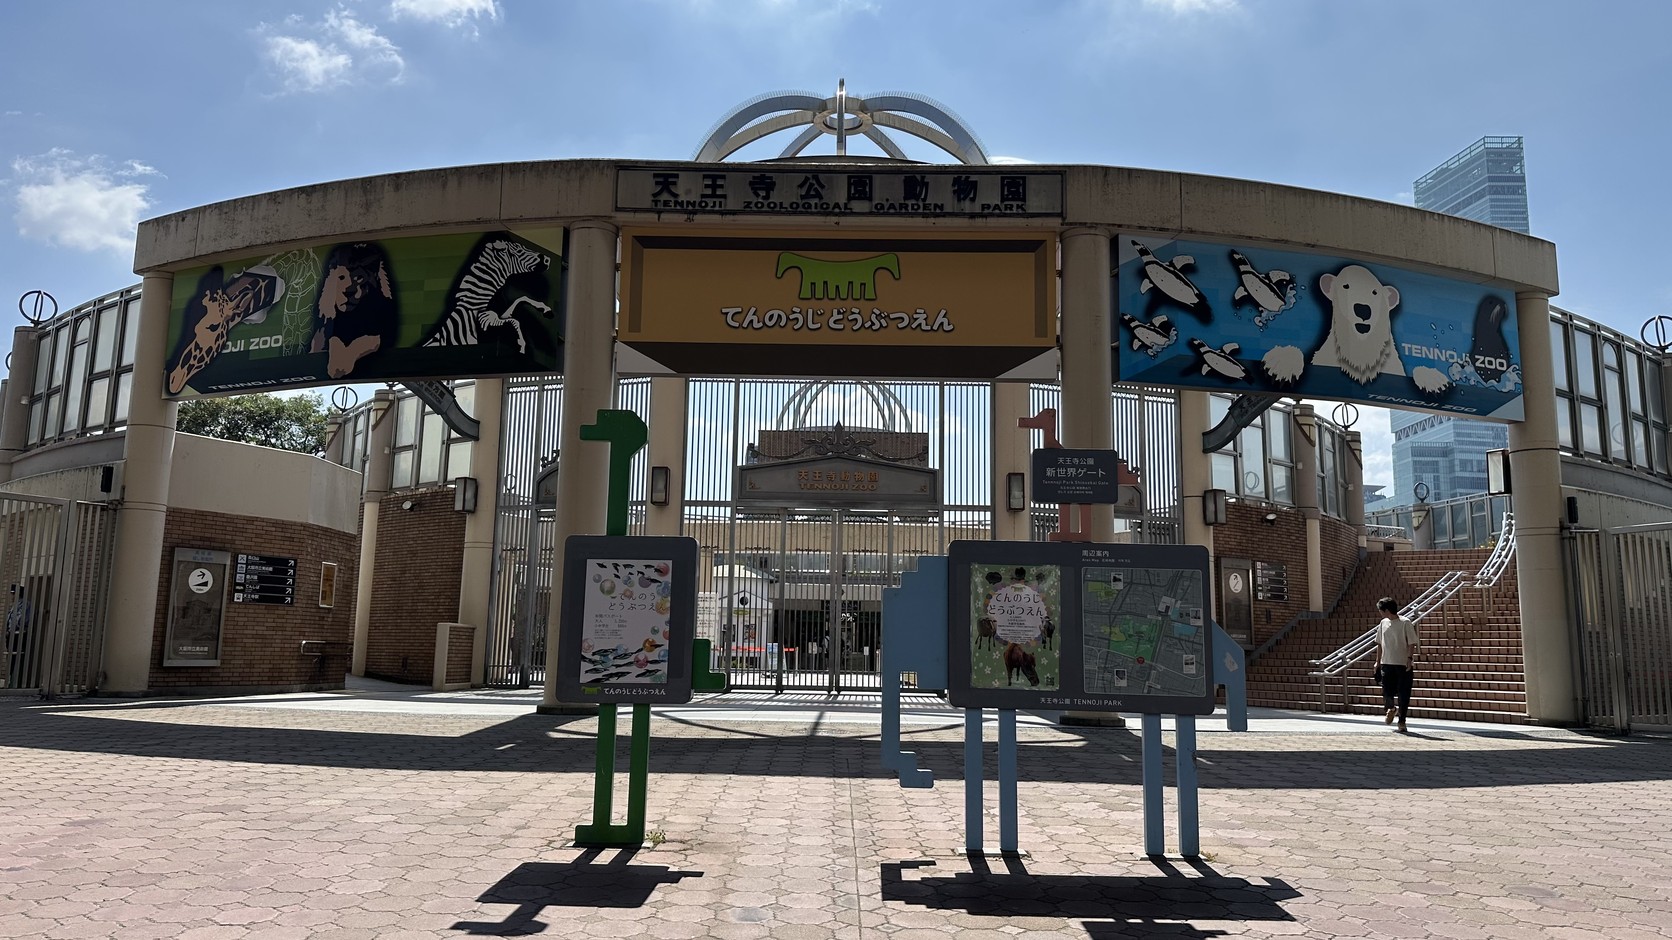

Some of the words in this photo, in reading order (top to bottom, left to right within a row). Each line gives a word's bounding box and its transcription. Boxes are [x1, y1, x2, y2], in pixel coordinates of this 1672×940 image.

[652, 172, 1027, 202] 天王寺公園動物園
[652, 200, 723, 209] TENNOJI
[743, 201, 853, 211] ZOOLOGICAL
[874, 202, 944, 211] GARDEN
[981, 203, 1026, 212] PARK
[249, 334, 283, 350] ZOO
[1401, 342, 1471, 363] TENNOJI
[1474, 354, 1507, 371] ZOO
[208, 379, 277, 390] TENNOJI
[279, 375, 317, 384] ZOO
[1367, 393, 1440, 407] TENNOJI
[1441, 404, 1478, 413] ZOO
[1057, 457, 1095, 465] 天王寺公園
[798, 469, 880, 482] 天王寺動物園
[1045, 467, 1106, 478] 新世界ゲート
[852, 483, 877, 491] ZOO
[995, 593, 1040, 604] てんのうじ
[608, 602, 666, 612] どうぶつえん
[988, 604, 1043, 616] どうぶつえん
[1039, 697, 1071, 705] 天王寺公園
[1073, 698, 1102, 706] TENNOJI
[1103, 699, 1123, 707] PARK
